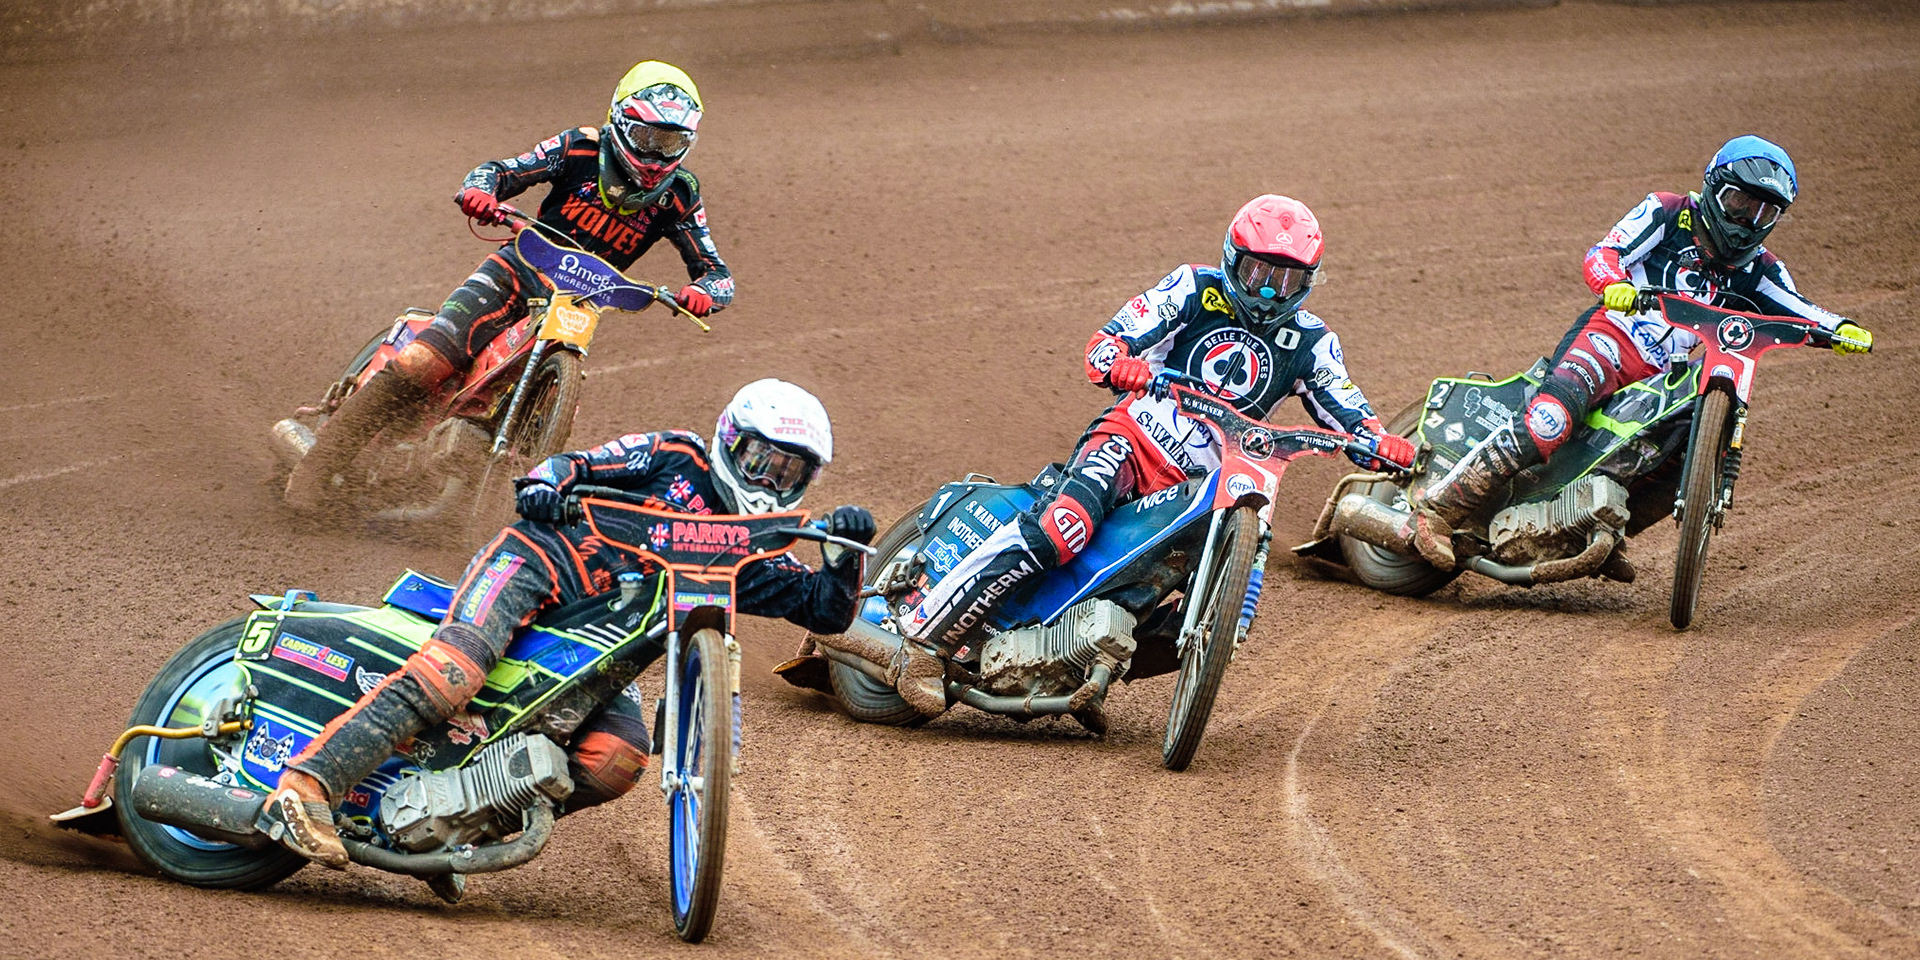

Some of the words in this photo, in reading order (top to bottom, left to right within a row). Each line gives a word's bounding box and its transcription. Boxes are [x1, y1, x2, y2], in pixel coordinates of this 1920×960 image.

[560, 193, 644, 255] WOLVES
[1282, 332, 1294, 347] 1
[1204, 332, 1236, 349] BELLE
[1240, 334, 1260, 351] VUE
[1257, 352, 1269, 380] ACES
[1430, 384, 1449, 404] 2
[1191, 399, 1224, 418] WARNER
[1539, 408, 1559, 432] ATPI
[1136, 411, 1153, 432] S.
[930, 492, 953, 520] 1
[672, 522, 751, 547] PARRYS
[677, 595, 706, 604] CARPETS
[941, 560, 1035, 646] INOTHERM
[243, 621, 276, 652] 5
[280, 637, 319, 656] CARPETS
[316, 646, 331, 663] 4
[325, 653, 350, 669] LESS
